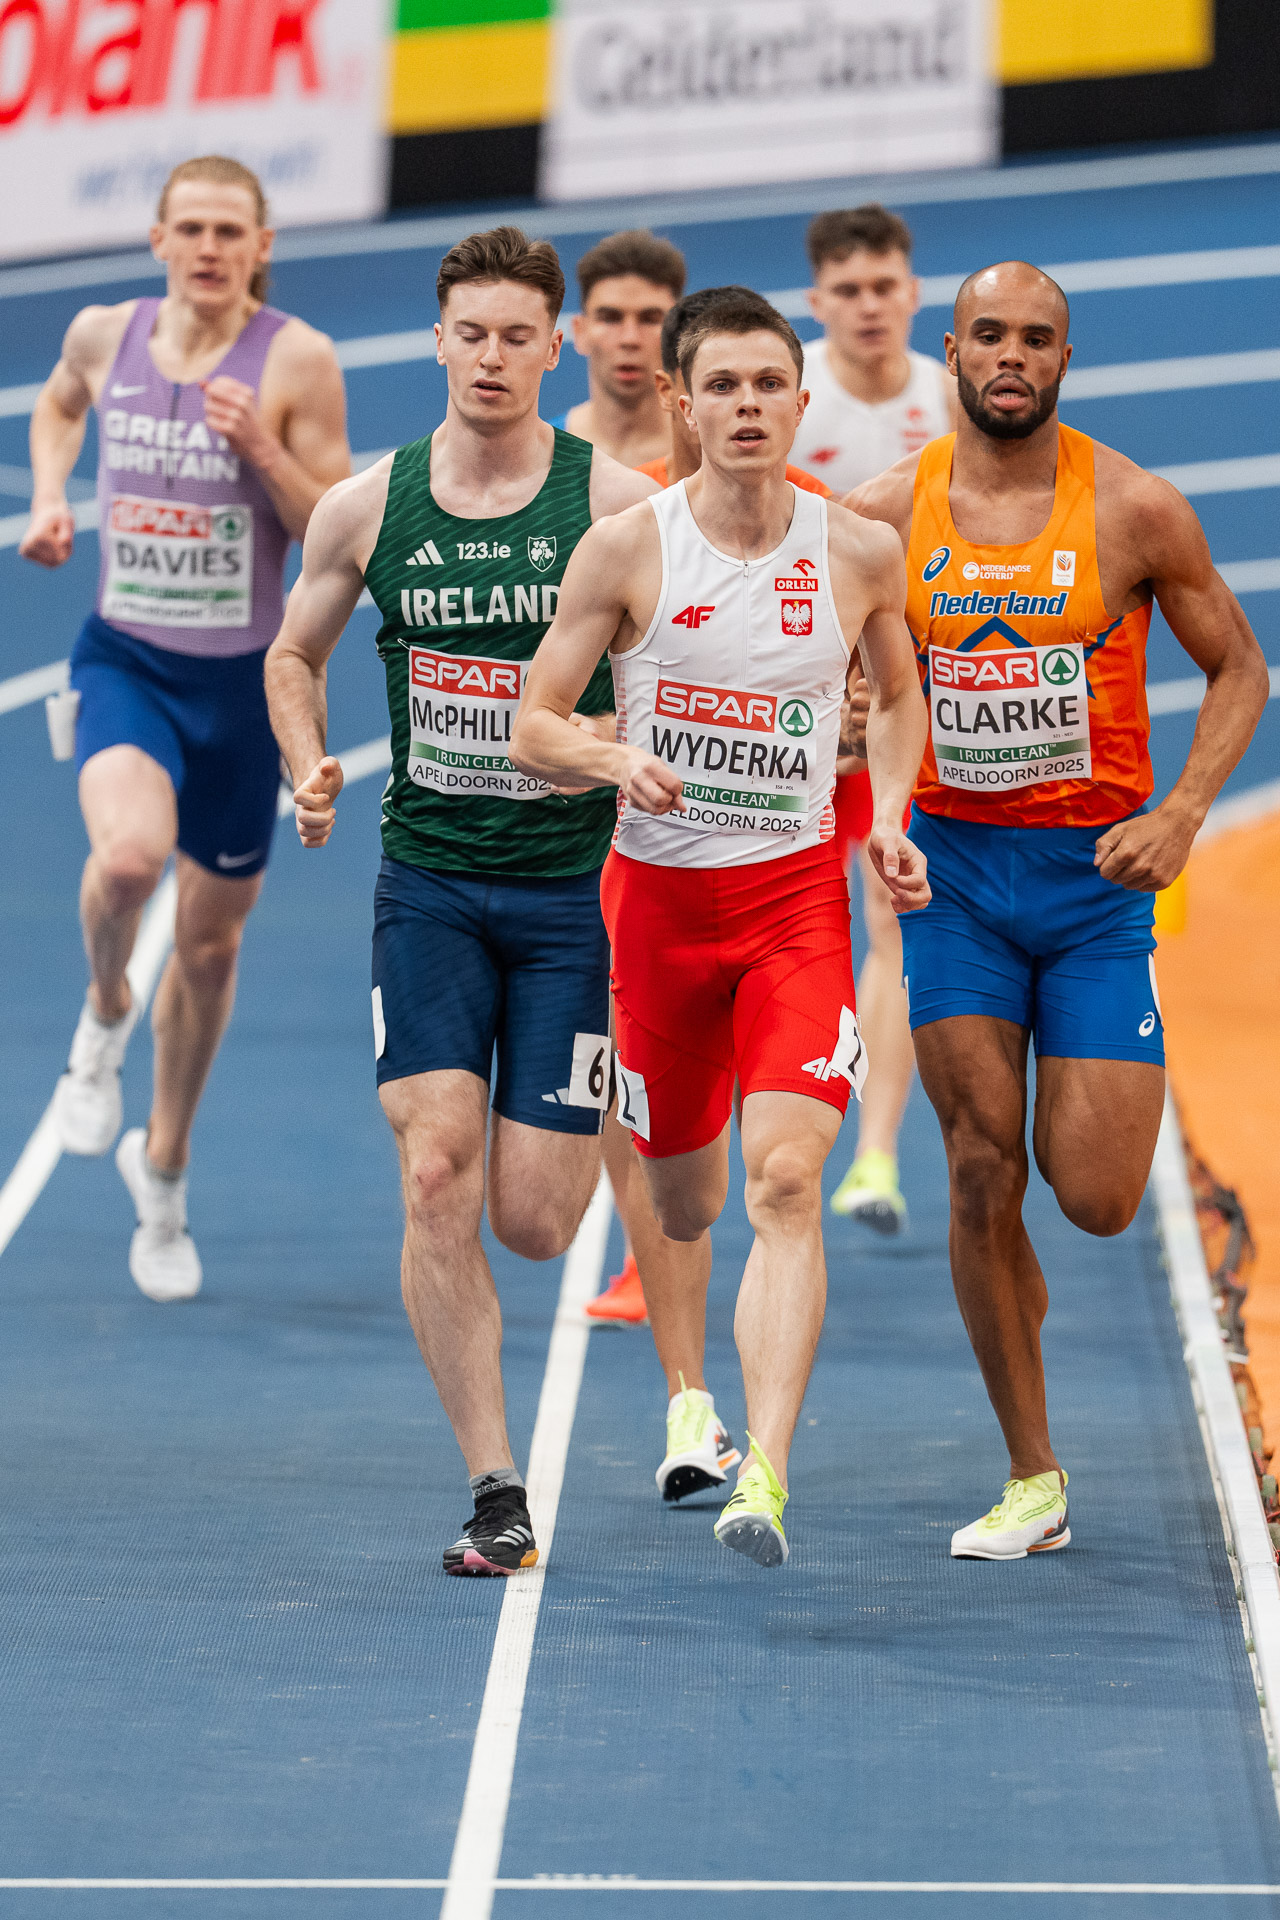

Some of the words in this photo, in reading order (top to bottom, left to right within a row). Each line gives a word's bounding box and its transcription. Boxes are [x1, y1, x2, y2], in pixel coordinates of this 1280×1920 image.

[107, 441, 240, 483] BRITAIN
[117, 540, 241, 577] DAVIES
[456, 542, 512, 560] 123.ie
[980, 564, 1031, 573] NEDERLANDSE
[980, 572, 1014, 580] LOTERIJ
[776, 580, 816, 591] ORLEN
[401, 584, 560, 627] IRELAND
[671, 605, 716, 629] 4F
[414, 656, 518, 695] SPAR
[933, 656, 1036, 687] SPAR
[659, 686, 774, 728] SPAR
[936, 694, 1080, 735] CLARKE
[441, 751, 470, 768] RUN
[472, 756, 516, 771] CLEA
[652, 725, 808, 781] WYDERKA
[965, 750, 997, 763] RUN
[412, 764, 513, 792] APELDOORN
[517, 778, 552, 793] 202
[943, 765, 1040, 785] APELDOORN
[1044, 758, 1085, 776] 2025
[683, 783, 717, 801] RUN
[760, 817, 802, 833] 2025
[588, 1046, 605, 1099] 6
